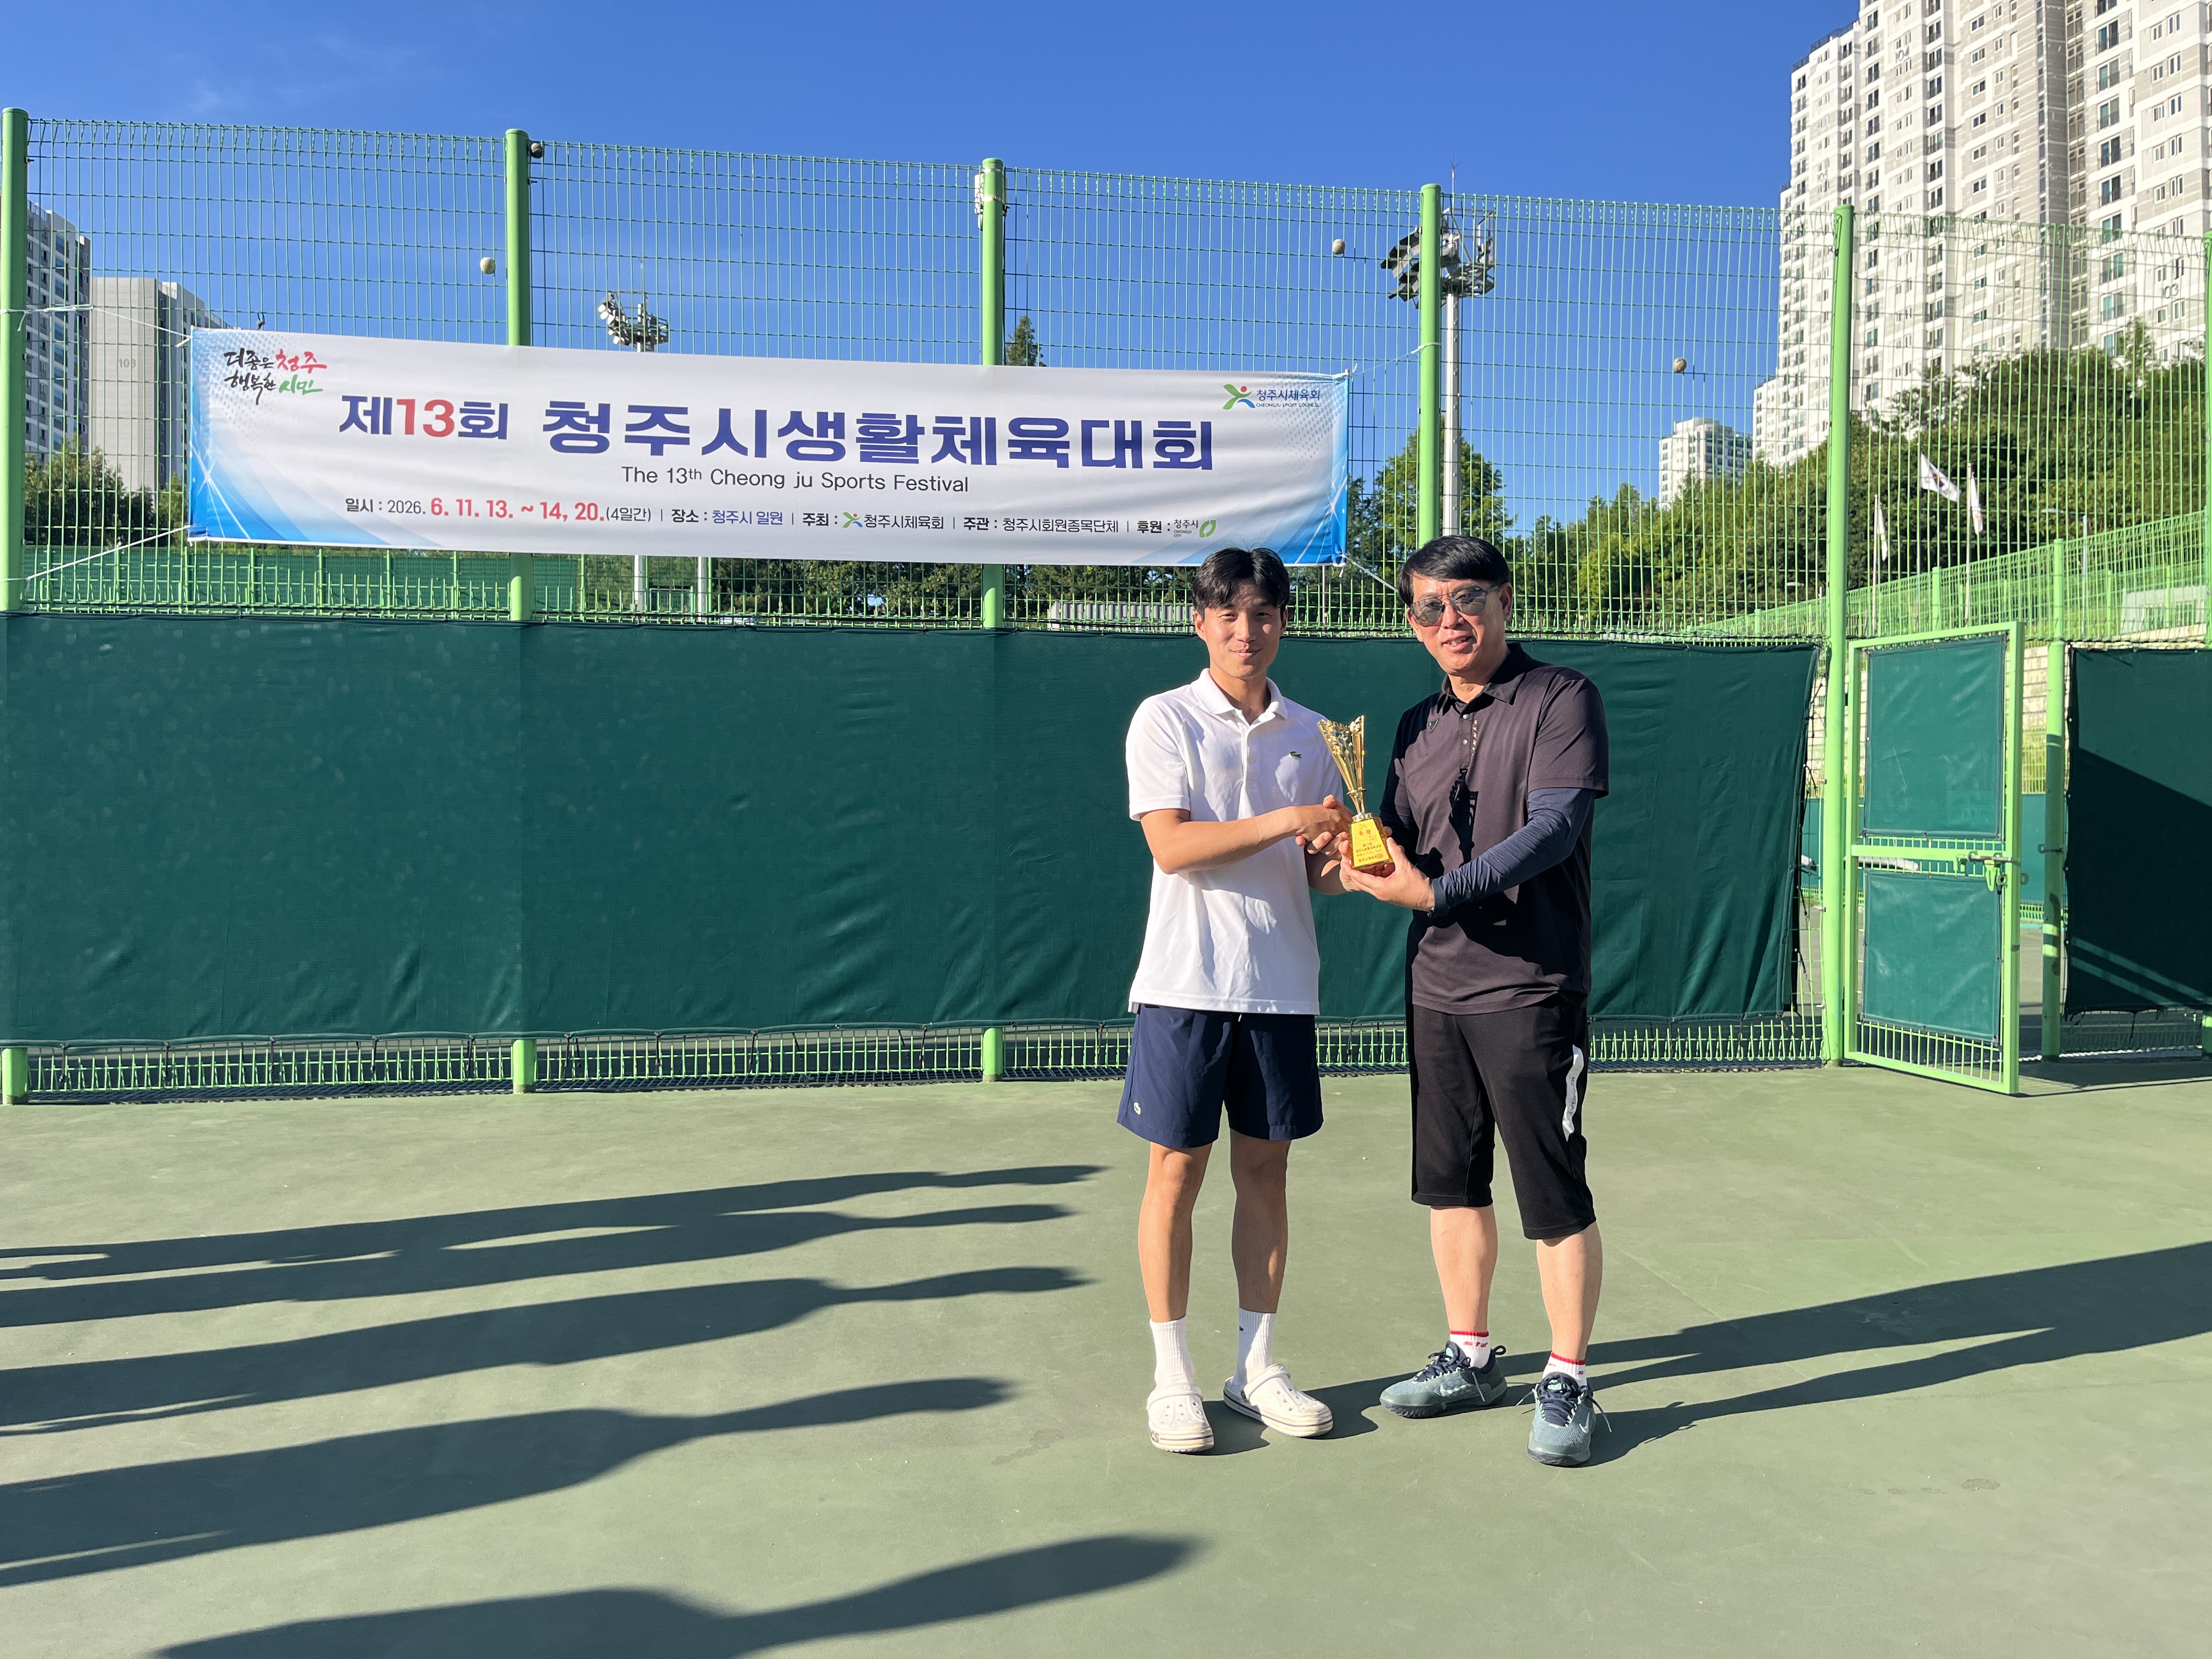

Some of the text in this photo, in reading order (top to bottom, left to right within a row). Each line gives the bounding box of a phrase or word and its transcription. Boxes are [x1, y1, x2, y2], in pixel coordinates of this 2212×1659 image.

[276, 348, 328, 374] 청주
[224, 369, 324, 406] 행복한 시민
[1256, 388, 1321, 401] 청주시체육회
[339, 395, 1212, 470] 제13회 청주시생활체육대회
[621, 466, 968, 492] The 13th Cheong ju Sports Festival
[346, 498, 374, 512] 일시
[387, 500, 426, 515] 2026.
[431, 497, 449, 516] 6.
[456, 499, 479, 517] 11.
[486, 500, 514, 518] 13.
[540, 501, 568, 522] 14,
[671, 509, 699, 523] 장소
[712, 510, 752, 524] 청주시
[756, 511, 783, 525] 일원
[803, 512, 829, 527] 주최
[864, 514, 944, 529] 청주시체육회
[963, 517, 990, 531] 주관
[1002, 518, 1119, 533] 청주시회원종목단체
[1137, 521, 1162, 534] 후원
[1173, 519, 1198, 529] 청주시
